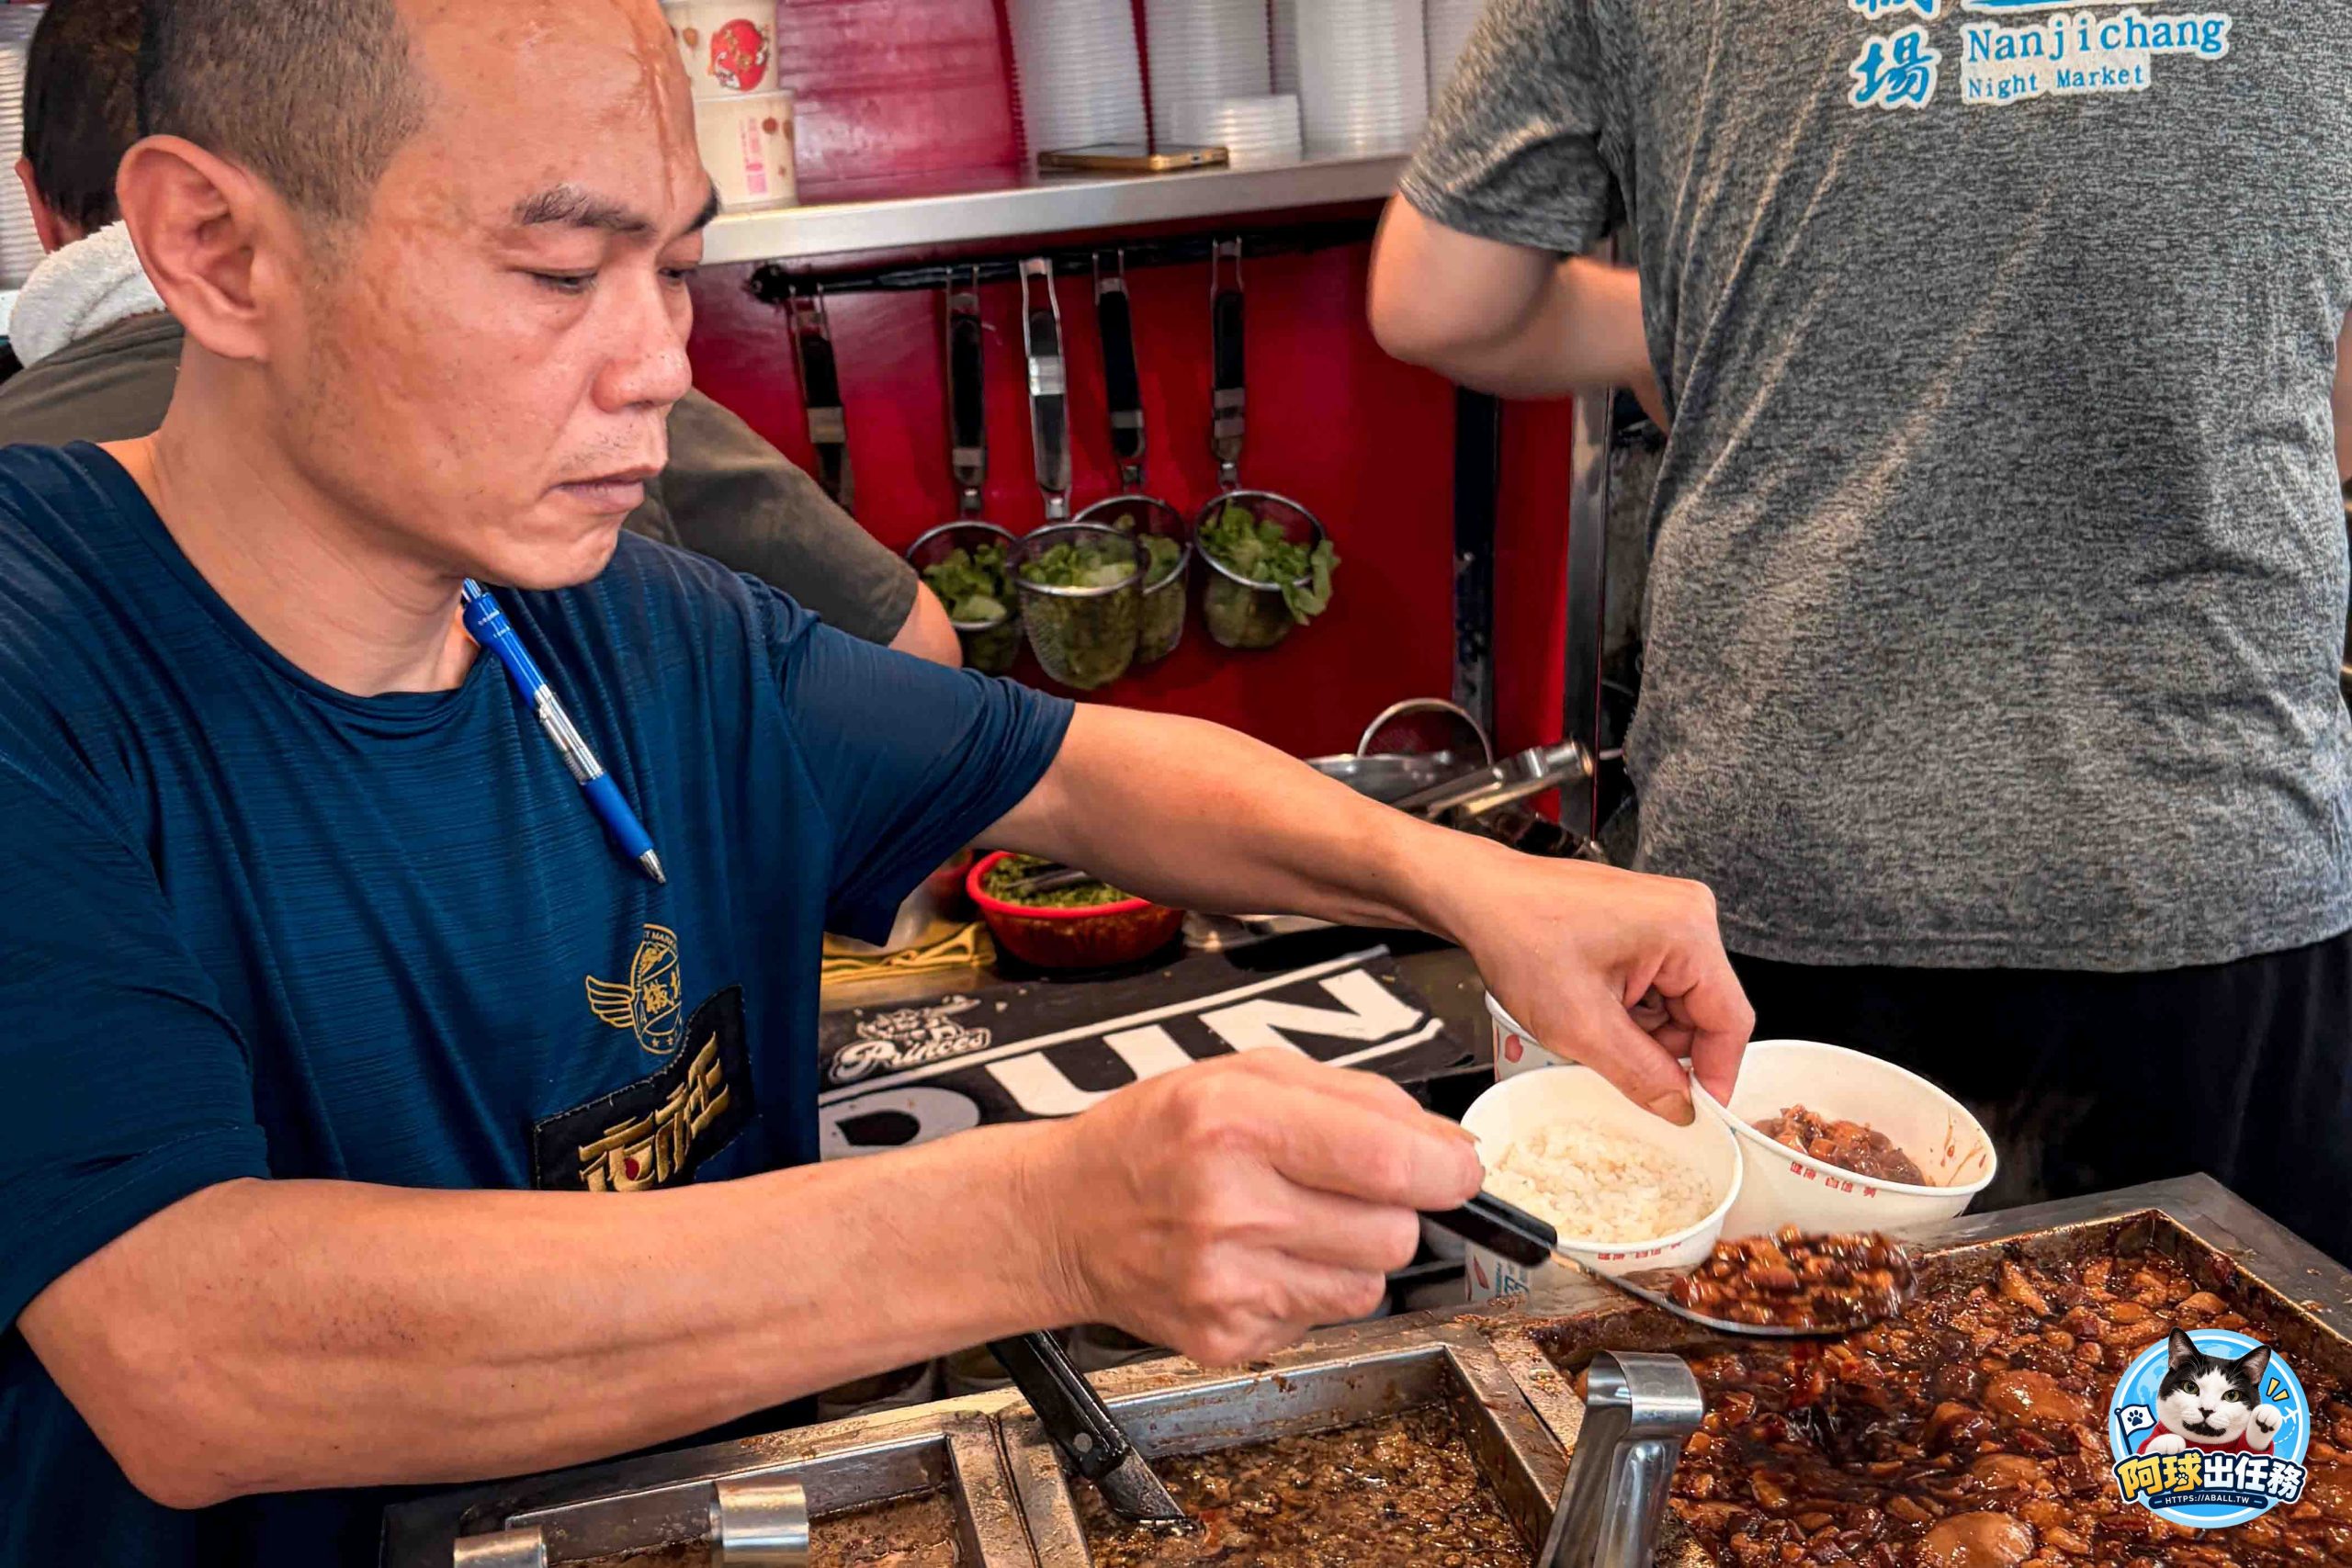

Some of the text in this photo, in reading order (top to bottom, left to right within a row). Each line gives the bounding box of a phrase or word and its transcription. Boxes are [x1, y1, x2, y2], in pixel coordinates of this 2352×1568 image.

[1968, 16, 2224, 62] Nanjichang
[1855, 30, 1933, 103] 場
[1968, 63, 2144, 99] Night Market
